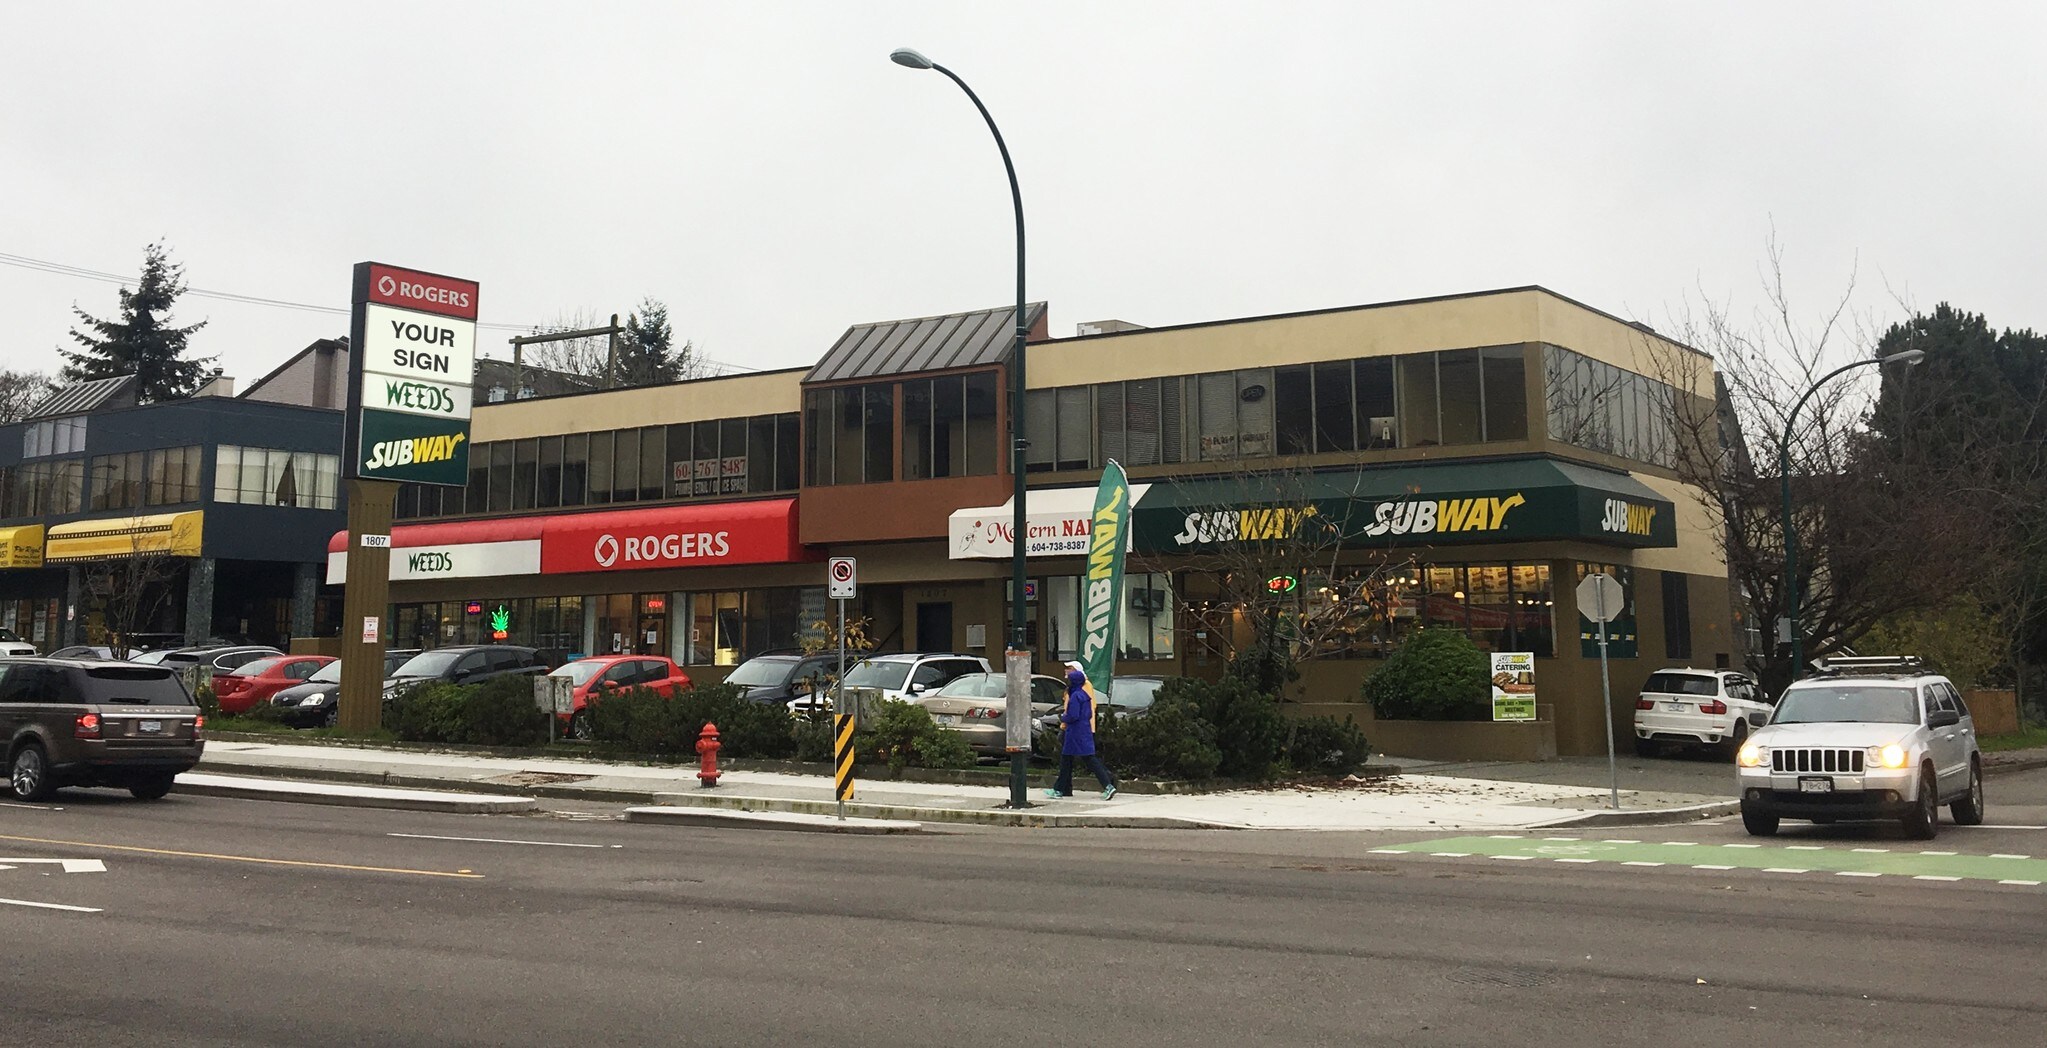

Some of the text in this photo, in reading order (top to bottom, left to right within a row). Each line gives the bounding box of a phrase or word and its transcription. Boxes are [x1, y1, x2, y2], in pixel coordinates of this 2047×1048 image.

[400, 281, 469, 307] ROGERS
[391, 320, 455, 347] YOUR
[393, 348, 449, 374] SIGN
[384, 378, 454, 413] WEEDS
[365, 431, 466, 471] SUBWAY
[1174, 504, 1318, 546] SUBWAY
[1363, 492, 1526, 538] SUBWAY
[1601, 498, 1656, 536] SUBWAY
[365, 536, 386, 546] 1807
[625, 531, 730, 561] ROGERS
[1031, 540, 1086, 552] 604-738-8387
[408, 551, 453, 574] WEEDS
[1083, 485, 1124, 662] SUBWAY
[1495, 663, 1531, 671] CATERING
